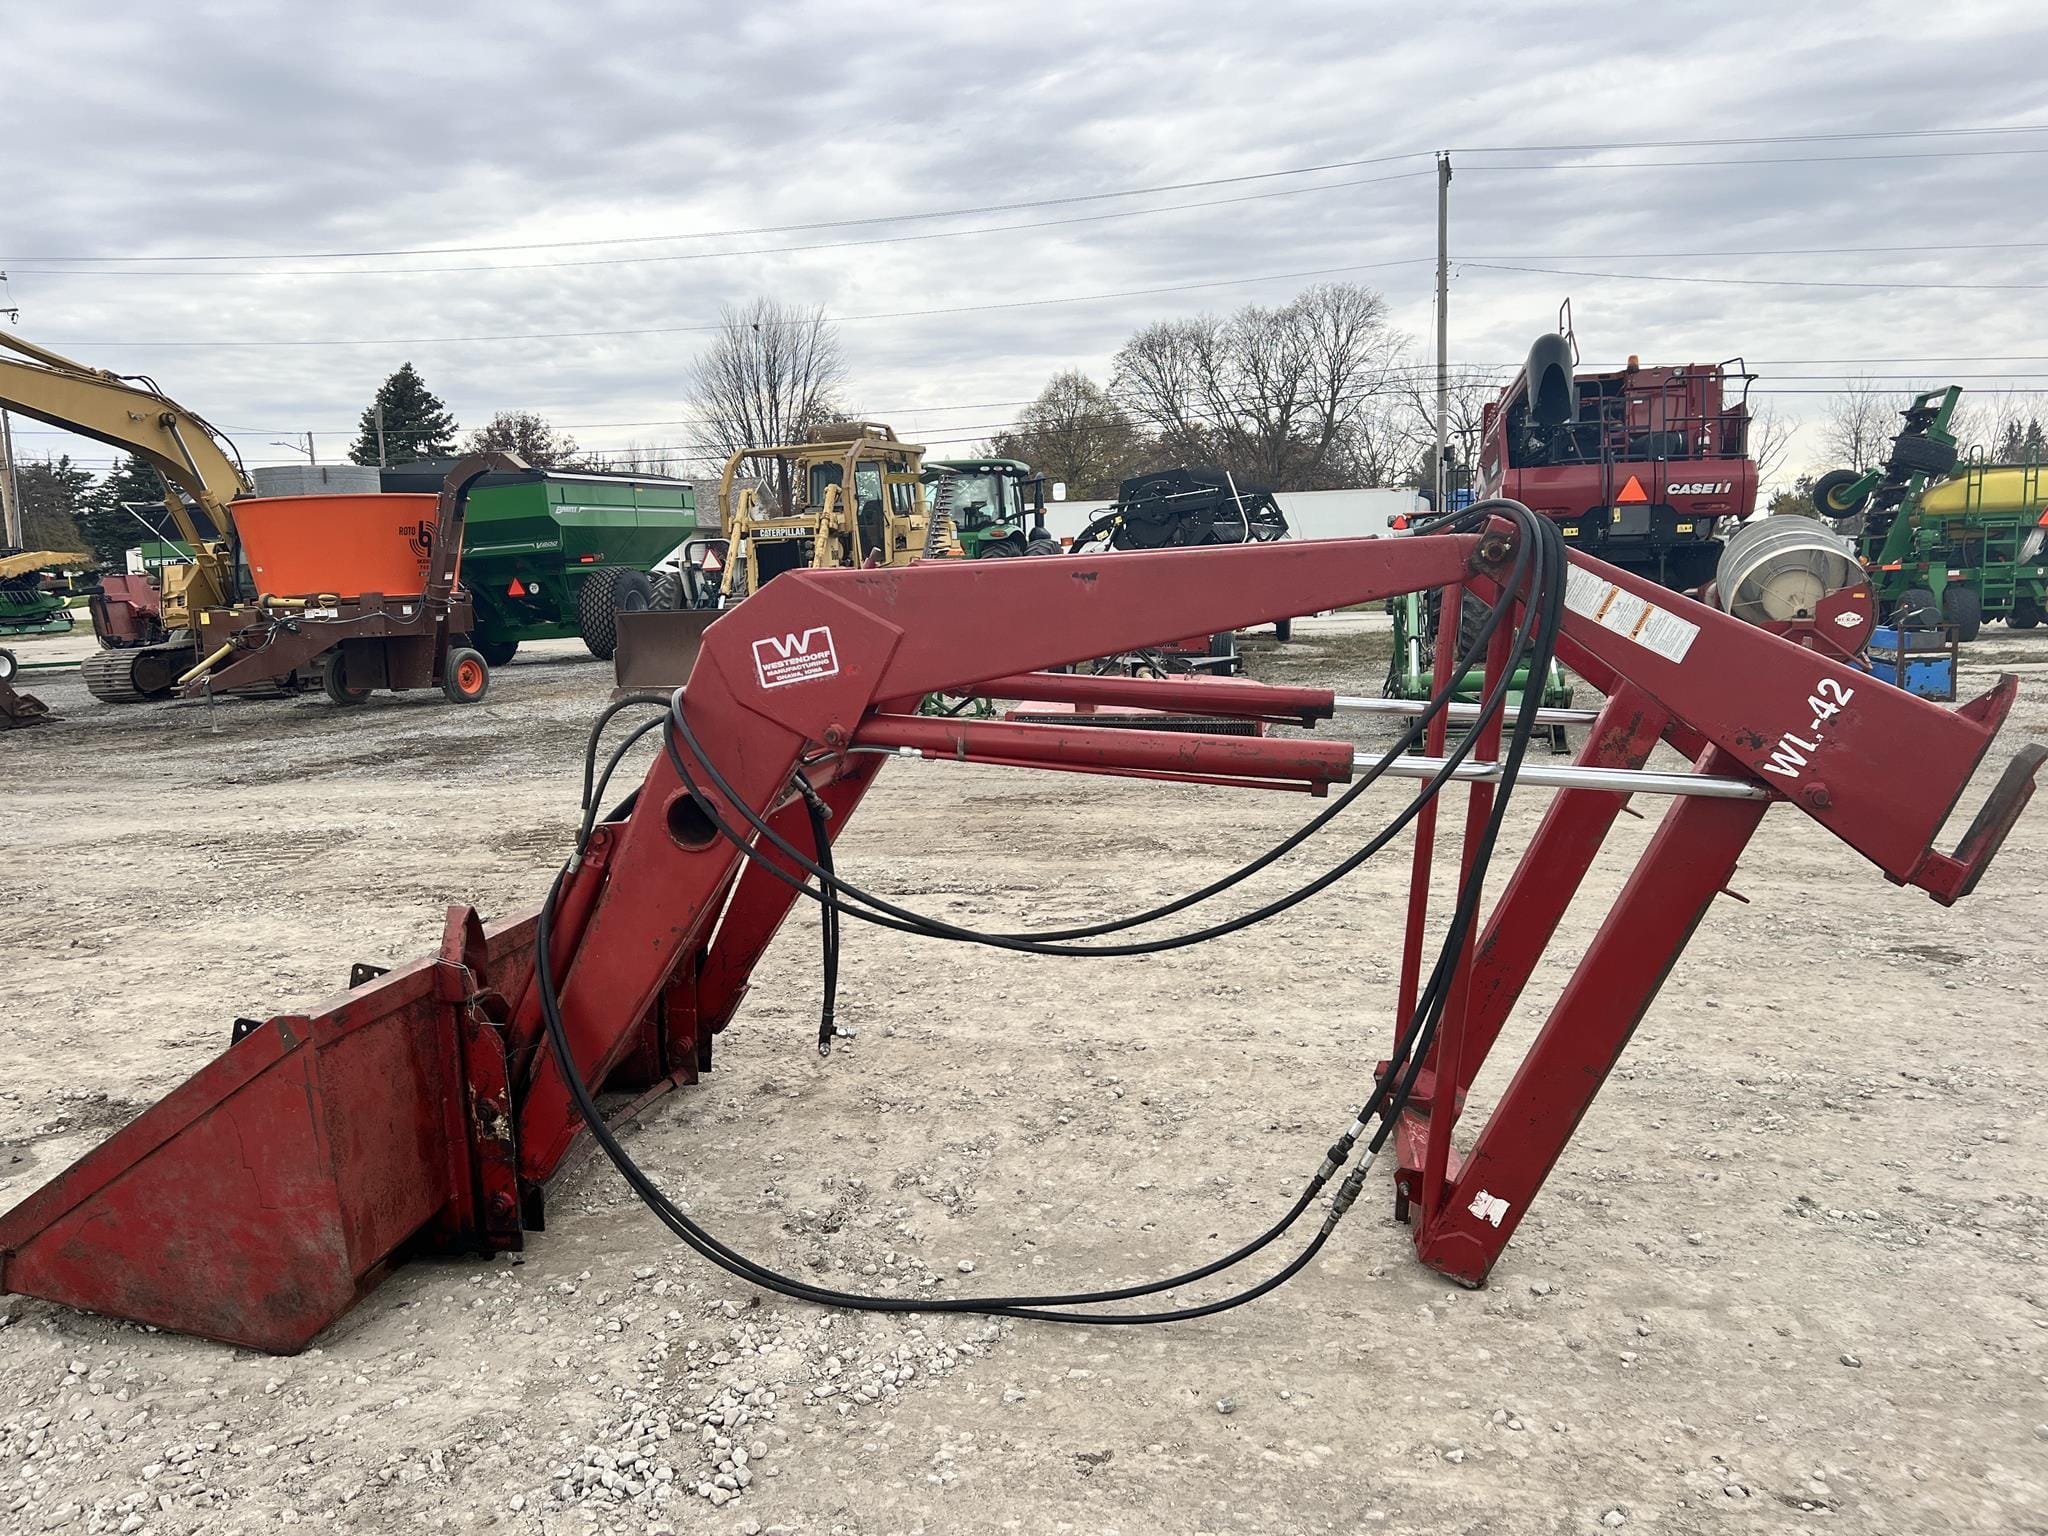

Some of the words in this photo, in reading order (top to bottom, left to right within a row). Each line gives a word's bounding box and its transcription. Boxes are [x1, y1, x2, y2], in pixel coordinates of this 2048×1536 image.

[1667, 483, 1714, 494] CASE
[399, 526, 416, 535] ROTO
[760, 527, 806, 537] CATERPILLAR
[762, 650, 830, 671] WESTENDORF
[766, 658, 830, 677] MANUFACTURING
